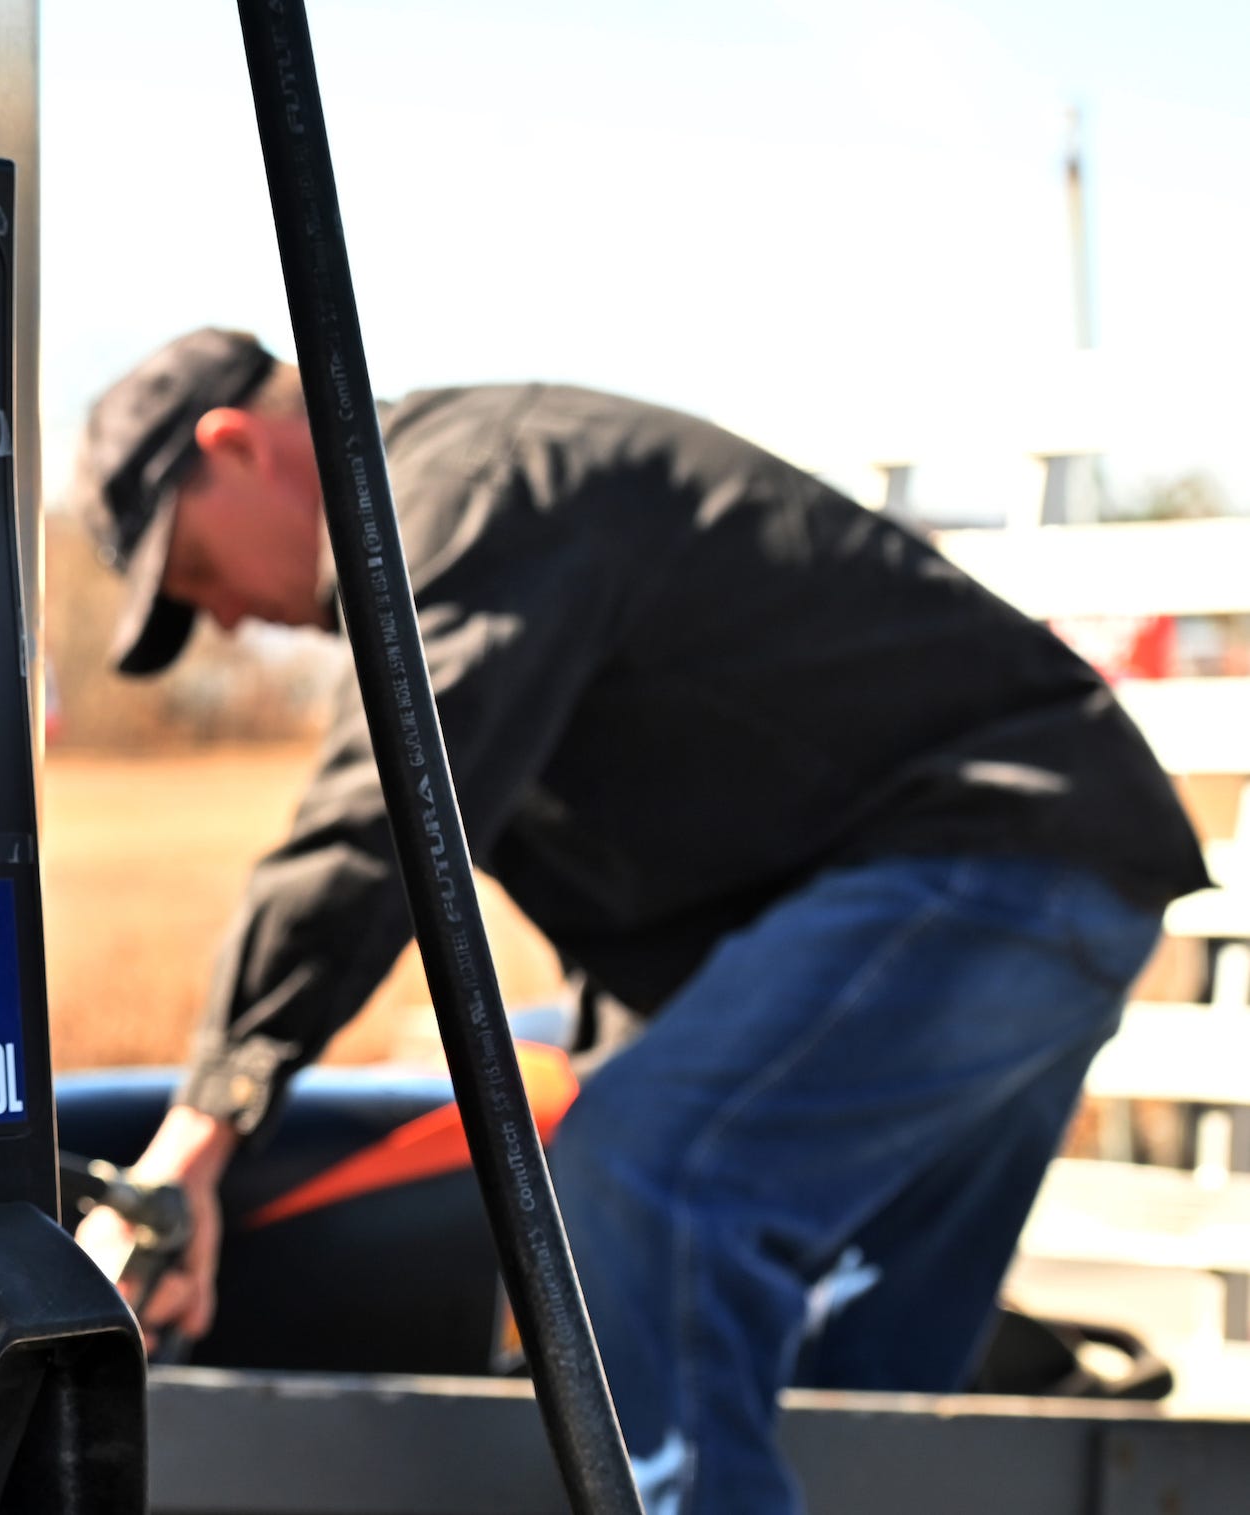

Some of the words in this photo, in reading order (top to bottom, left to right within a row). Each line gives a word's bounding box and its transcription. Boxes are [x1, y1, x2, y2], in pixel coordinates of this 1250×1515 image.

[370, 569, 388, 591] USA
[381, 611, 399, 644] MADE
[393, 677, 412, 708] HOSE
[400, 709, 425, 767] GASOLINE
[417, 774, 462, 923] FUTURA
[501, 1120, 535, 1212] ContiTech
